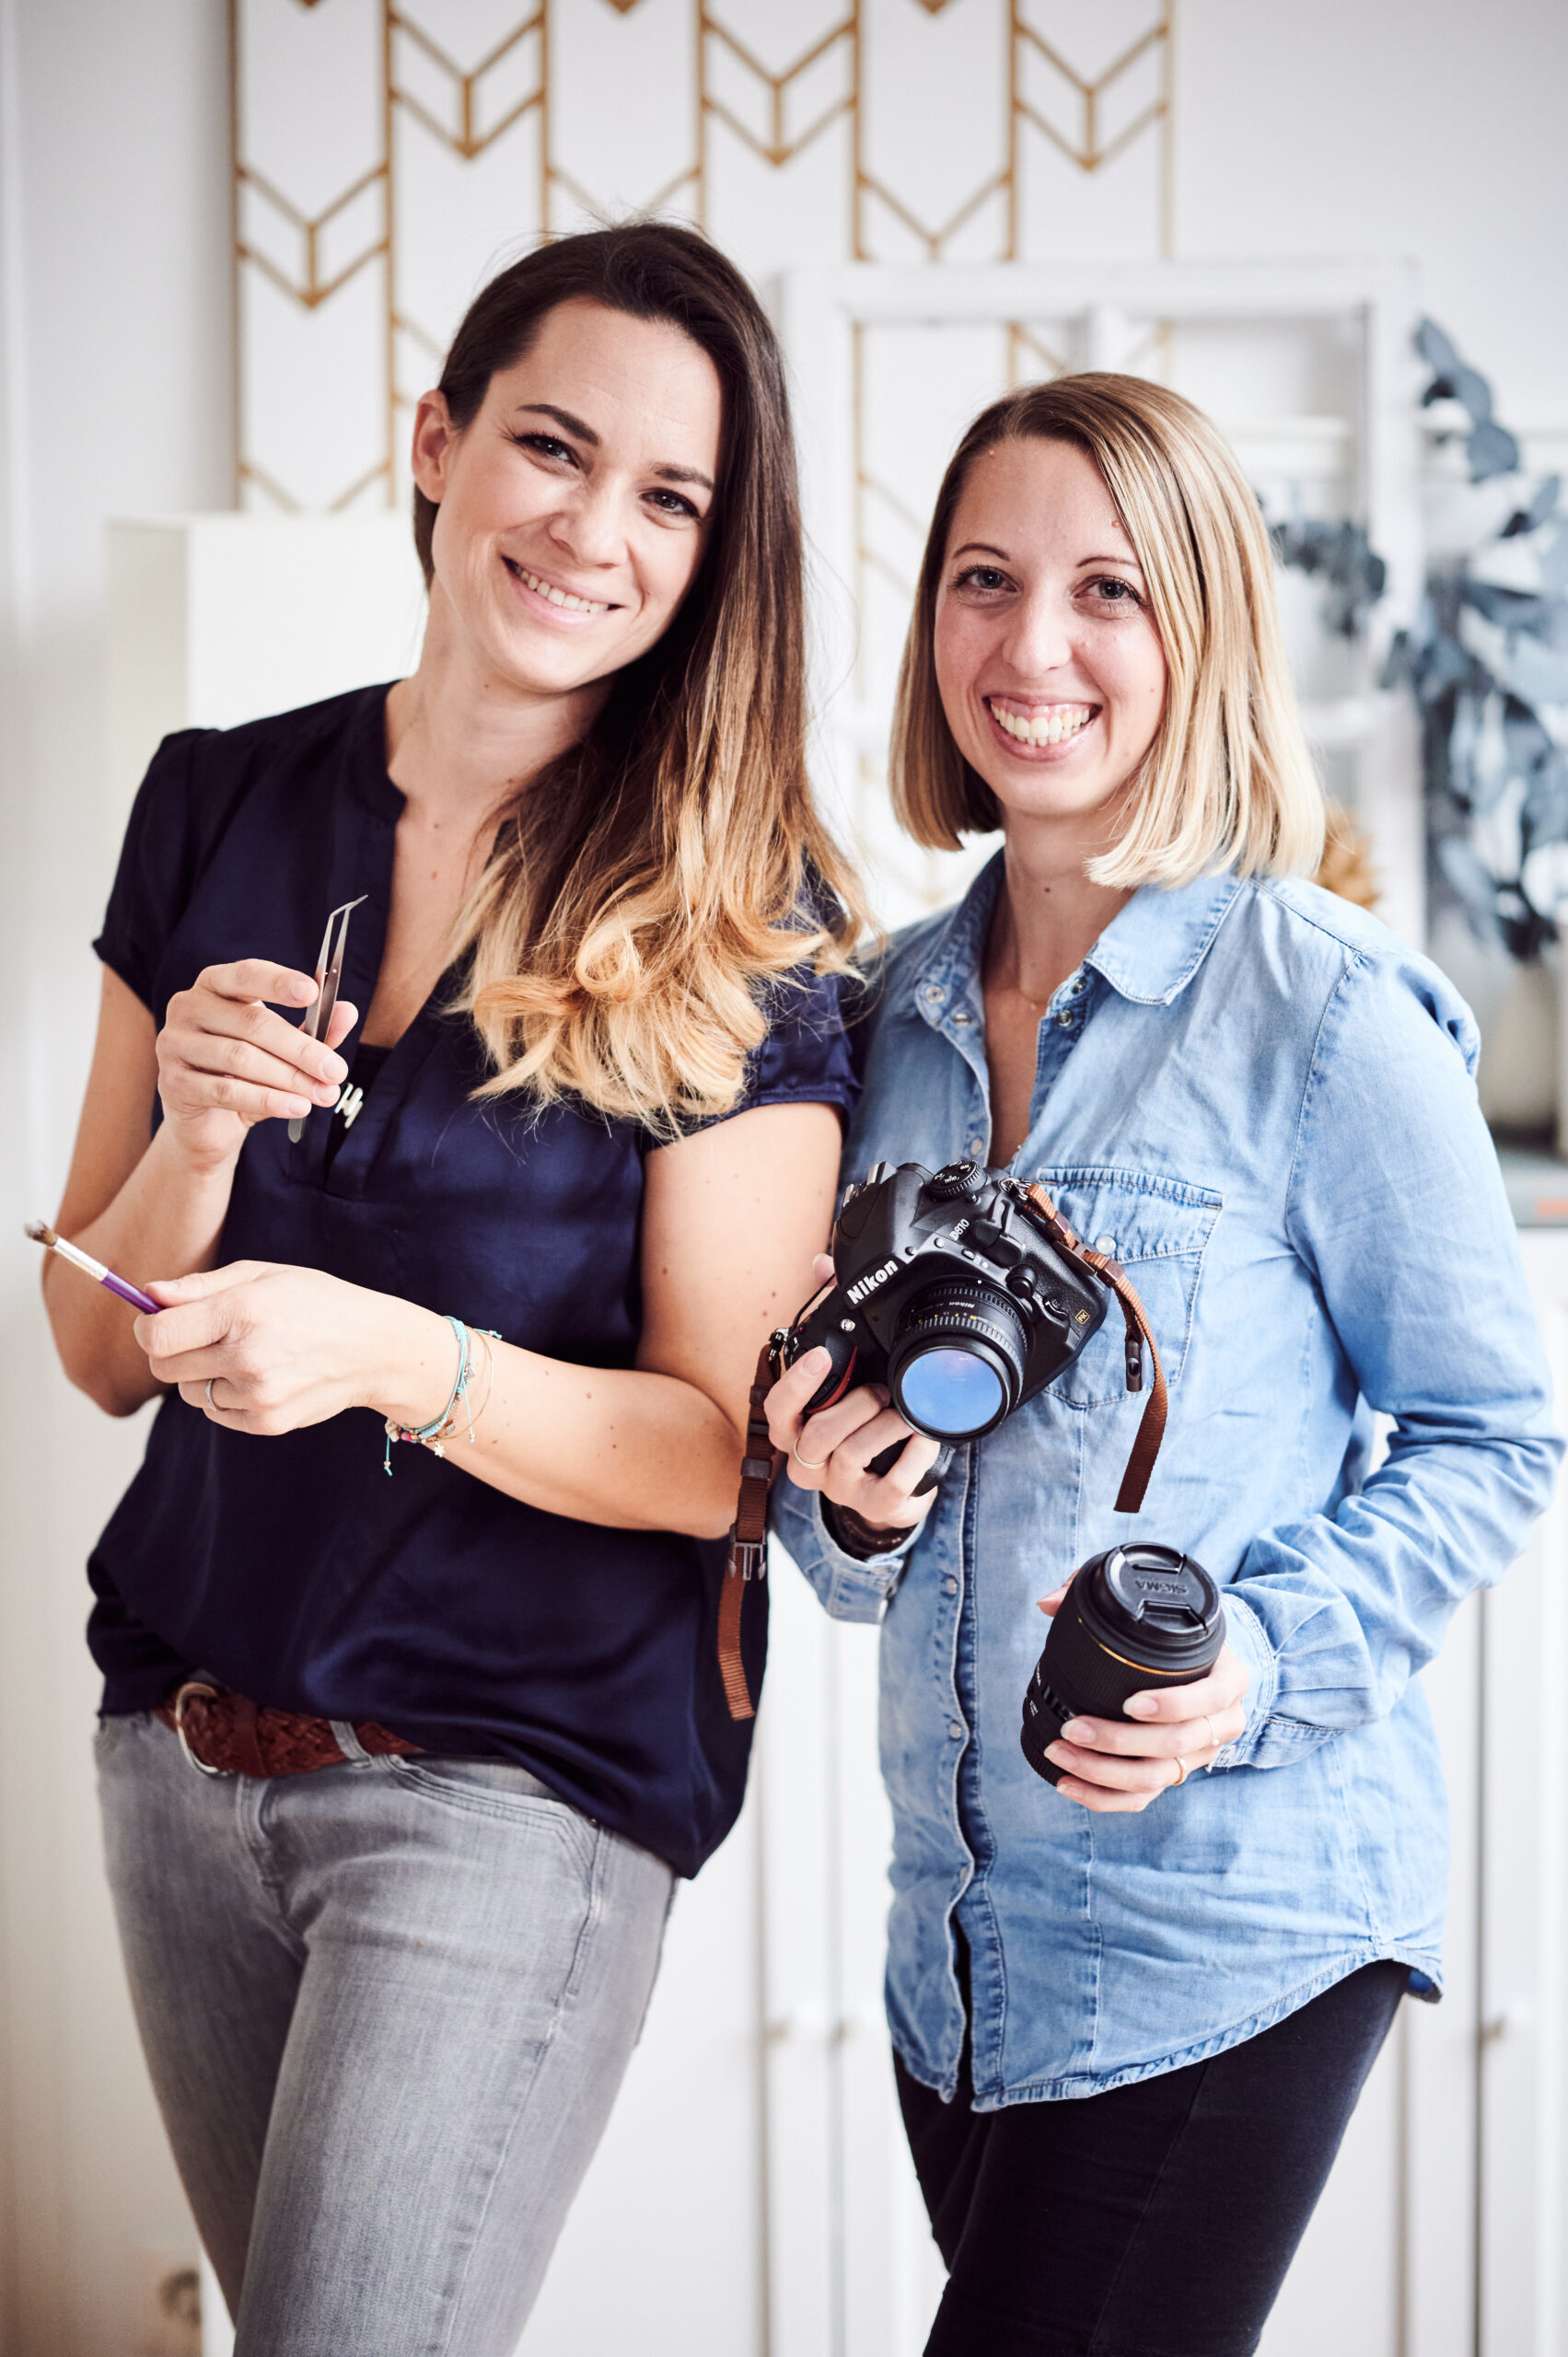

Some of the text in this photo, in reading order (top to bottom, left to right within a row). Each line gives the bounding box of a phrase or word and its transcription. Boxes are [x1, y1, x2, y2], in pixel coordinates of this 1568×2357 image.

[949, 1218, 970, 1241] D810
[846, 1260, 899, 1305] Nikon
[948, 1301, 975, 1309] Nikon
[1134, 1579, 1187, 1594] SIGMA
